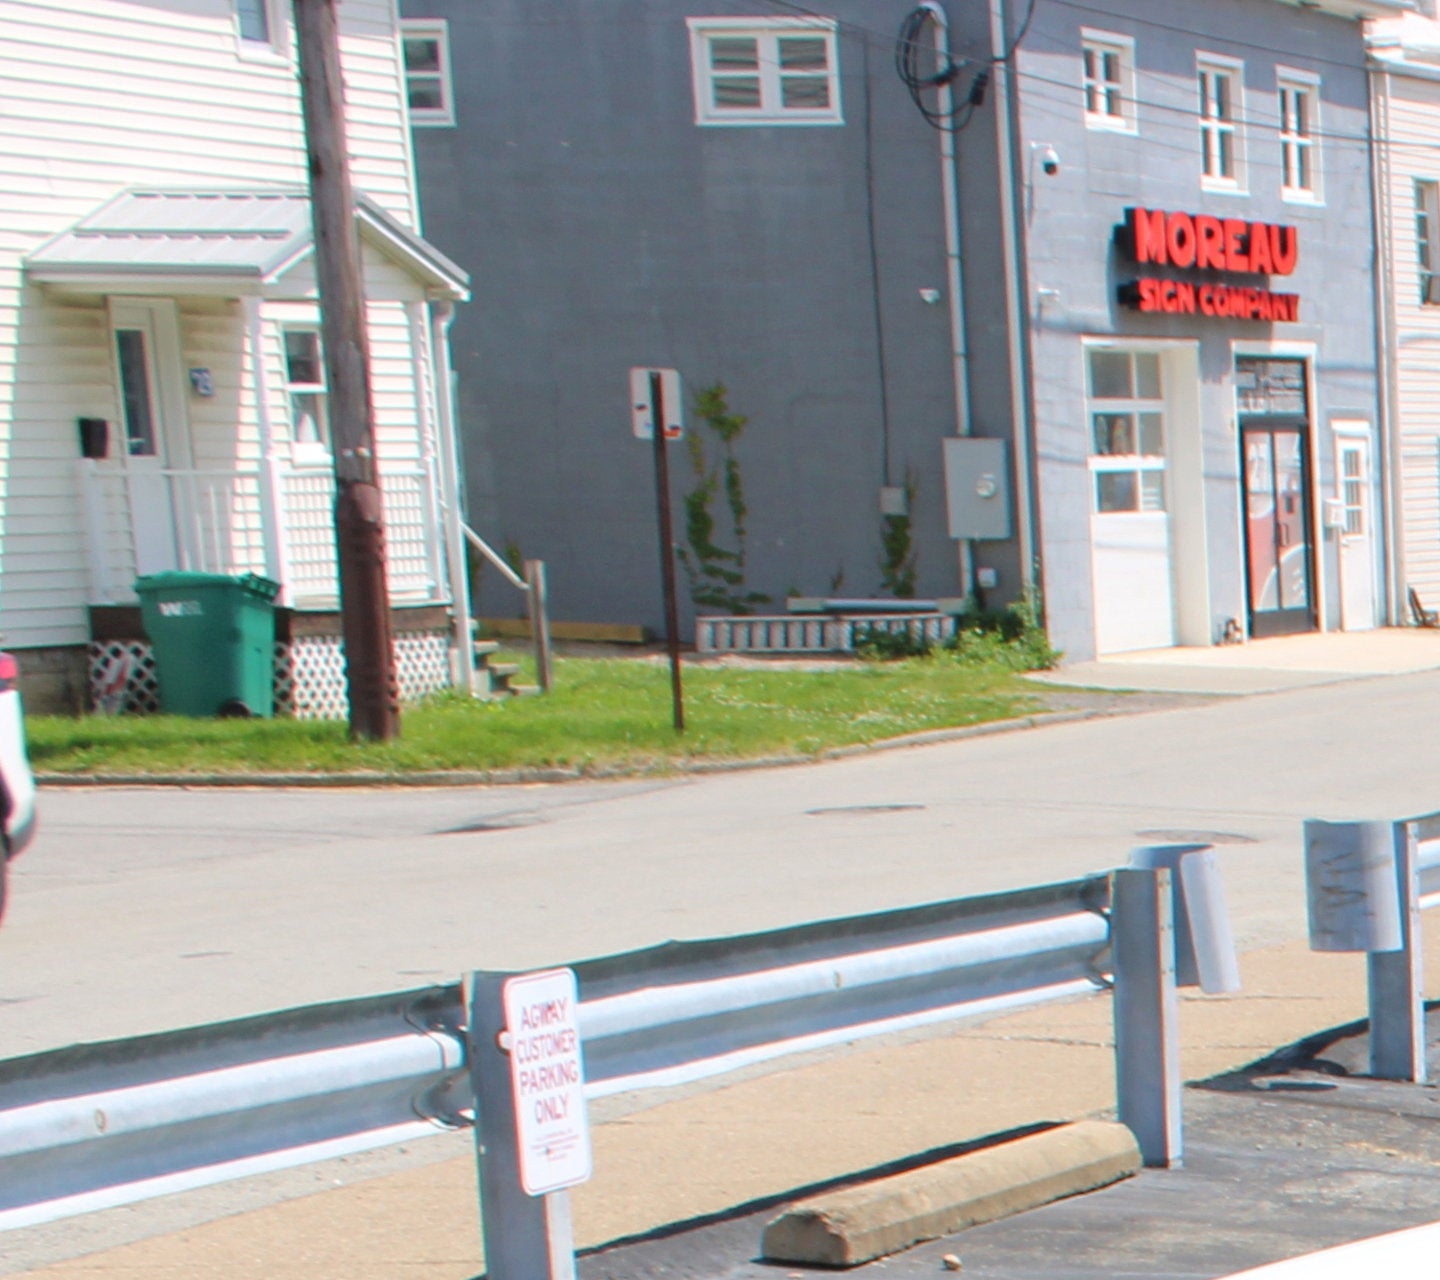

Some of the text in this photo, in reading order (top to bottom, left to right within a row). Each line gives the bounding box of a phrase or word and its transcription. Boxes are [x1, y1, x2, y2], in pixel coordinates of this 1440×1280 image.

[1134, 207, 1297, 275] MOREAU
[1138, 278, 1299, 322] SIGN COMPANY
[521, 998, 568, 1031] AGWAY
[516, 1029, 576, 1064] CUSTOMER
[519, 1060, 578, 1095] PARKING
[535, 1093, 569, 1124] ONLY
